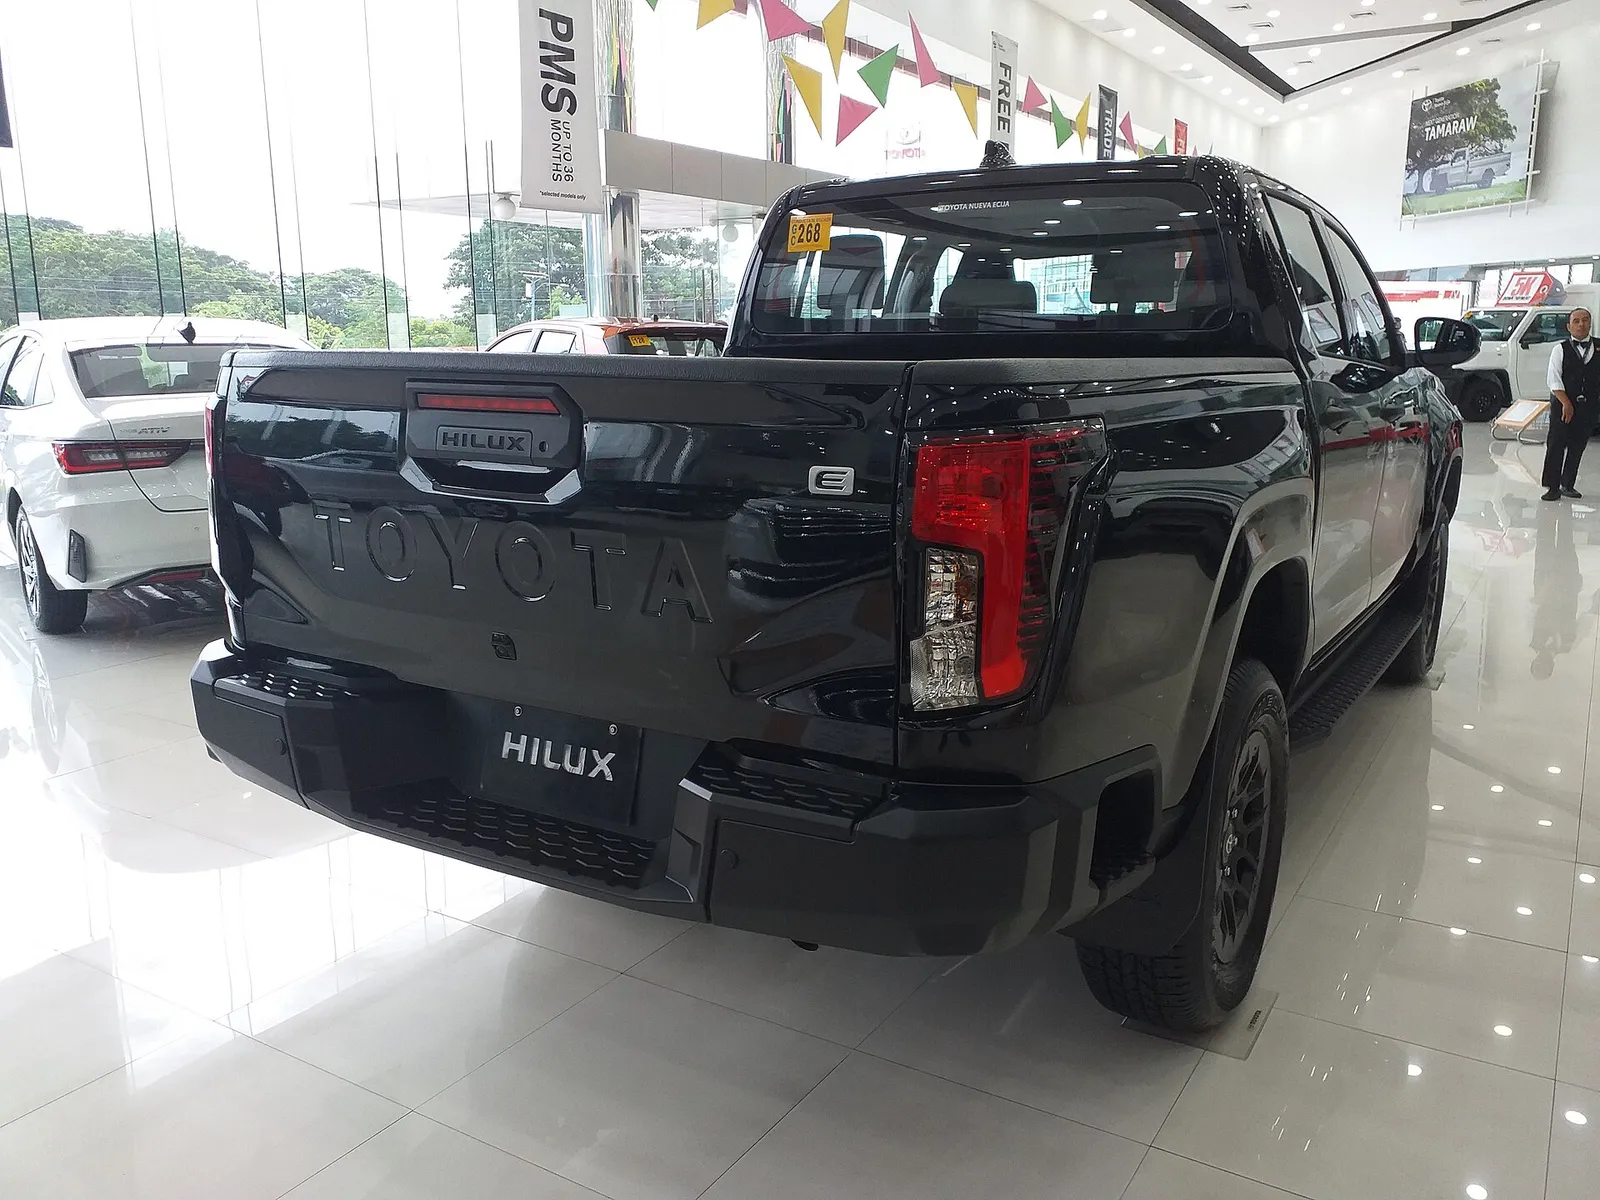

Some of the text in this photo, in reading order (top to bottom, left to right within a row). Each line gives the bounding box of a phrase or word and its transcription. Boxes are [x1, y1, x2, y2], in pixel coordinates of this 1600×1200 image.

[538, 7, 578, 116] PMS
[997, 61, 1012, 133] FREE
[550, 118, 562, 182] MONTHS
[562, 121, 574, 182] UP TO 36
[1103, 108, 1113, 159] TRADE
[1424, 115, 1478, 141] TAMARAW
[797, 222, 821, 243] 268
[442, 431, 526, 452] HILUX
[313, 499, 714, 623] TOYOTA
[501, 731, 616, 782] HILUX
